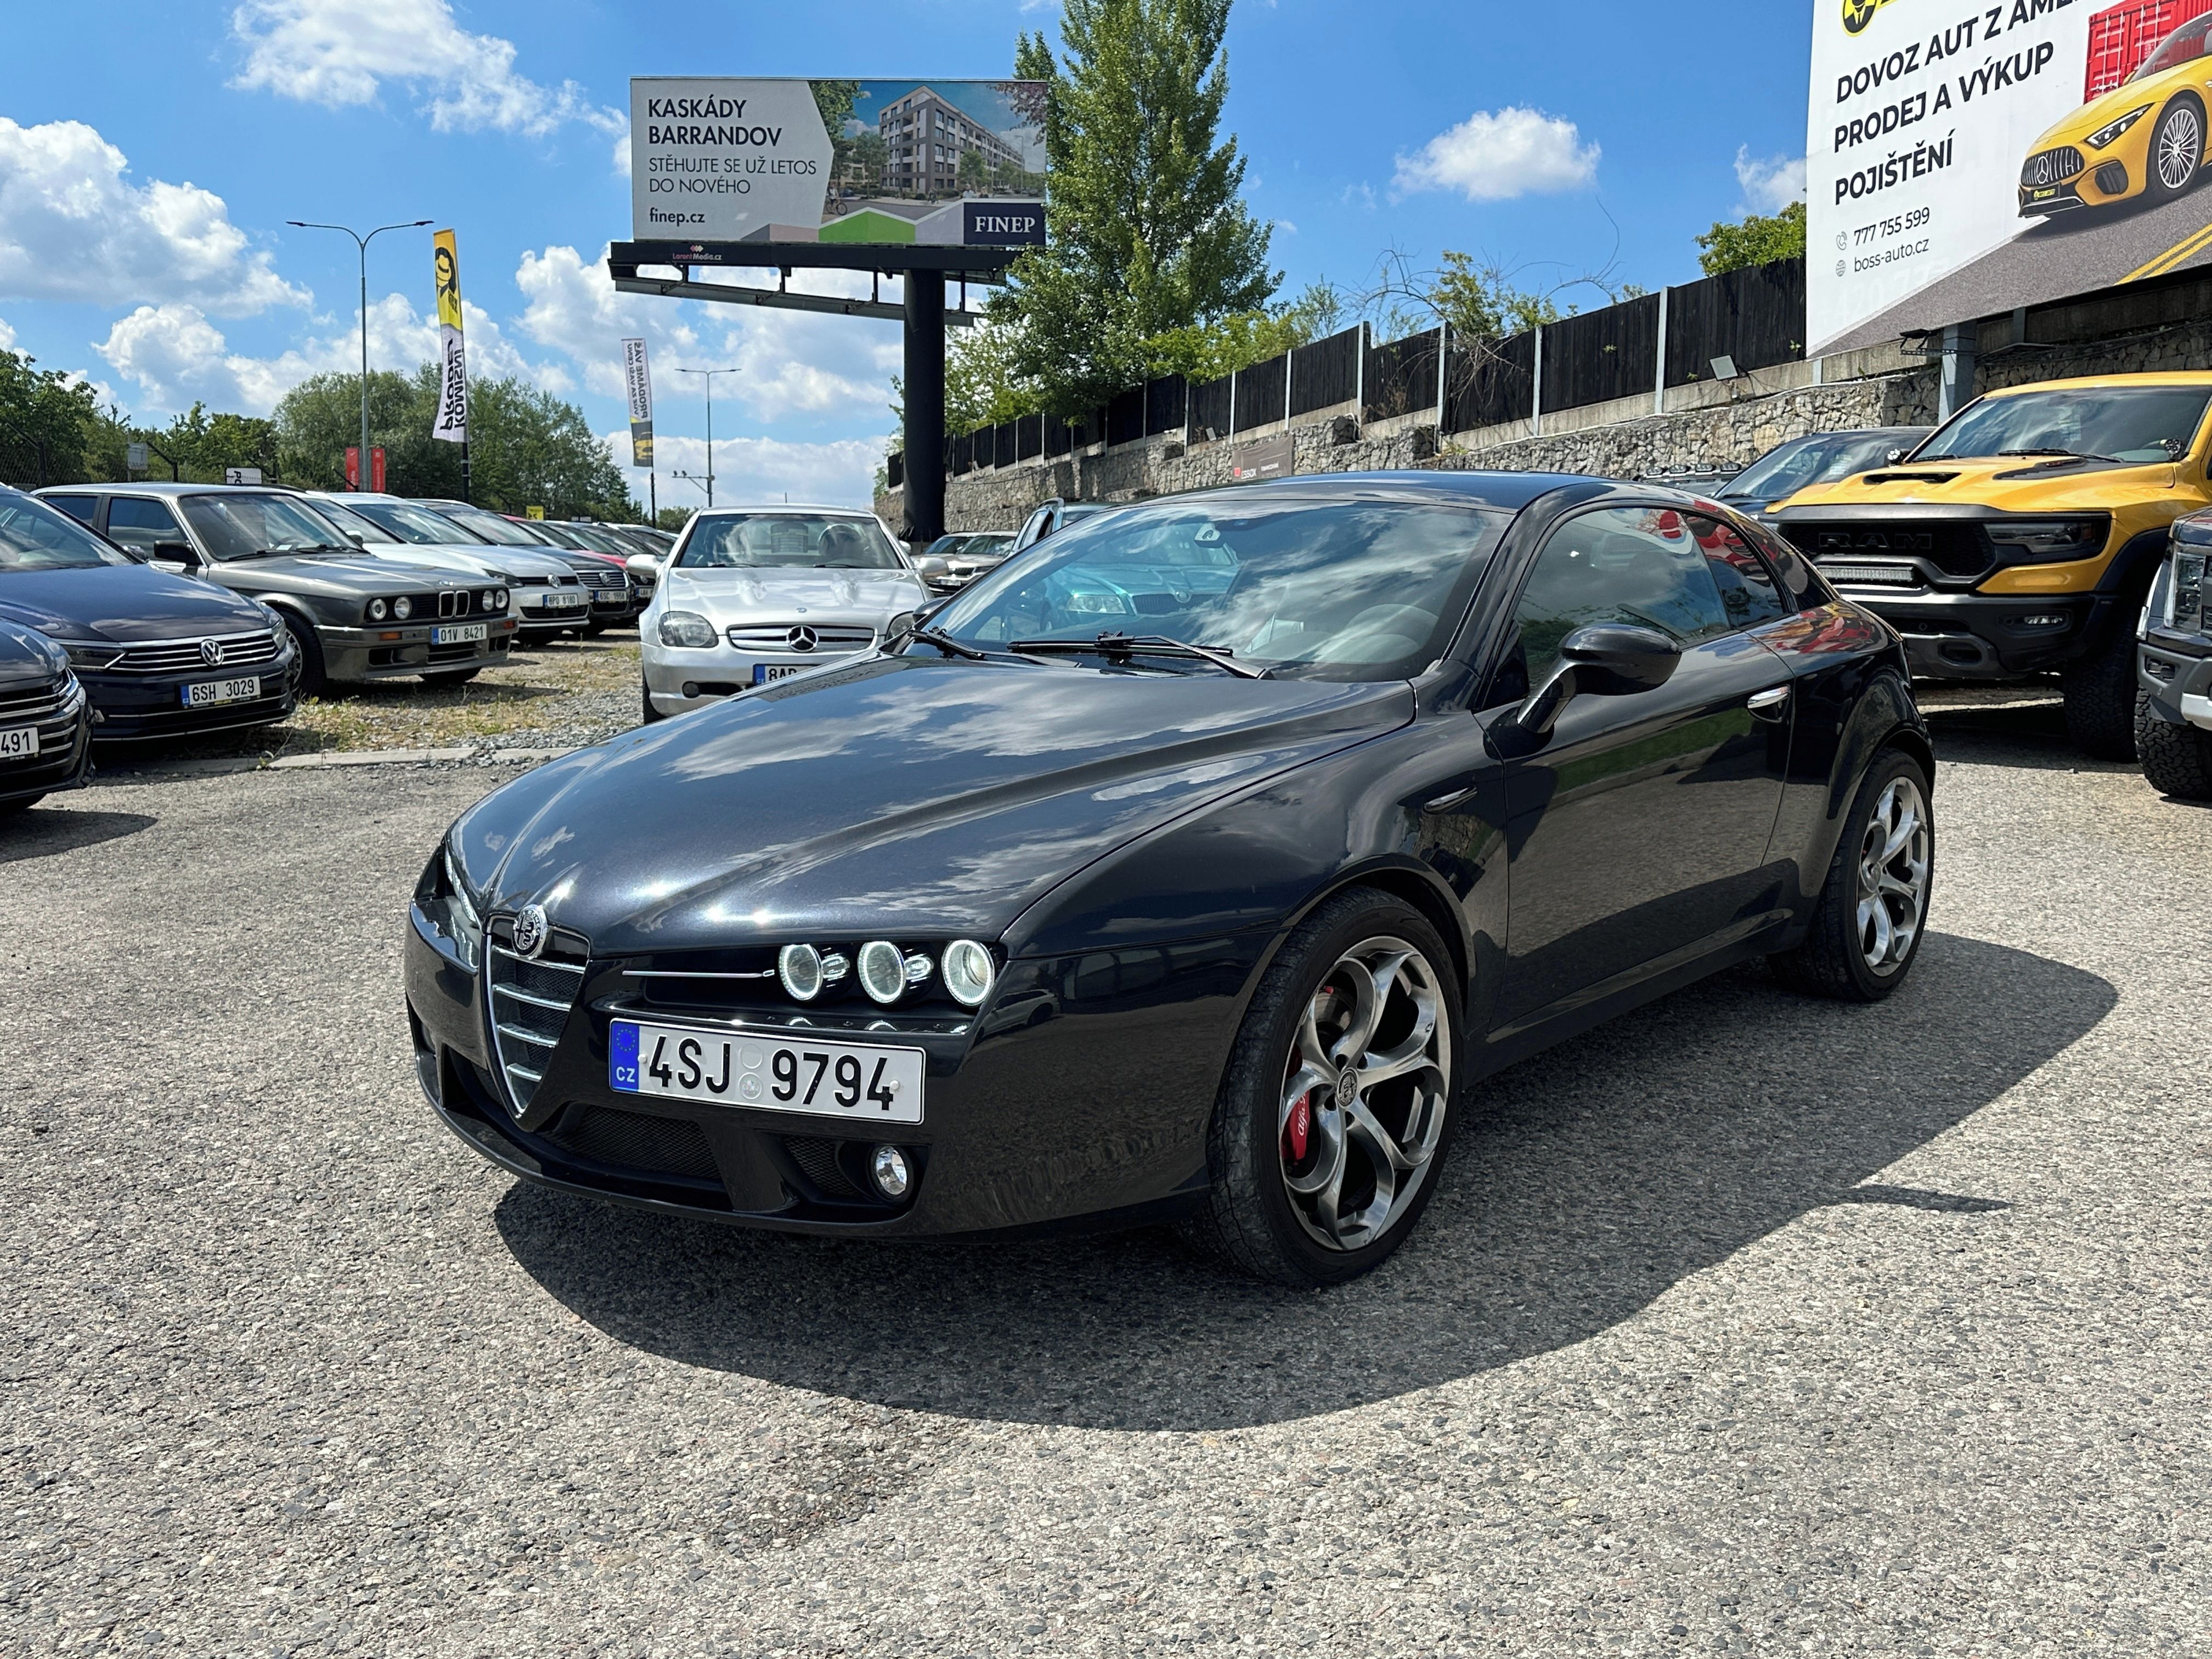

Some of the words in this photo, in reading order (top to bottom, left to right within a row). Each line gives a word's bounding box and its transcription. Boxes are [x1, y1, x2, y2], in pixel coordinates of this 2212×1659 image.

[1837, 42, 1920, 103] DOVOZ
[1925, 16, 1979, 66] AUT
[1984, 5, 2002, 41] Z
[648, 94, 747, 119] KASKÁDY
[1835, 92, 1926, 153] PRODEJ
[1932, 83, 1951, 115] A
[1959, 42, 2053, 102] VÝKUP
[649, 126, 782, 146] BARRANDOV
[649, 154, 719, 172] STĚHUJTE
[724, 159, 741, 173] SE
[746, 155, 766, 174] UŽ
[771, 160, 816, 175] LETOS
[1836, 128, 1956, 205] POJIŠTĚNÍ
[650, 179, 674, 193] DO
[680, 175, 751, 194] NOVÉHO
[650, 207, 706, 227] finep.cz
[975, 216, 1035, 233] FINEP
[1854, 224, 1876, 246] 777
[1880, 216, 1902, 238] 755
[1905, 207, 1930, 230] 599
[1854, 238, 1929, 272] boss-auto.cz
[1819, 532, 1933, 549] RAM
[441, 629, 458, 642] 01V
[464, 625, 483, 640] 8421
[193, 684, 216, 702] 6SH
[225, 679, 255, 697] 3029
[1, 731, 30, 754] 491
[616, 1066, 635, 1083] CZ
[650, 1035, 731, 1094] 4SJ
[771, 1049, 894, 1111] 9794
